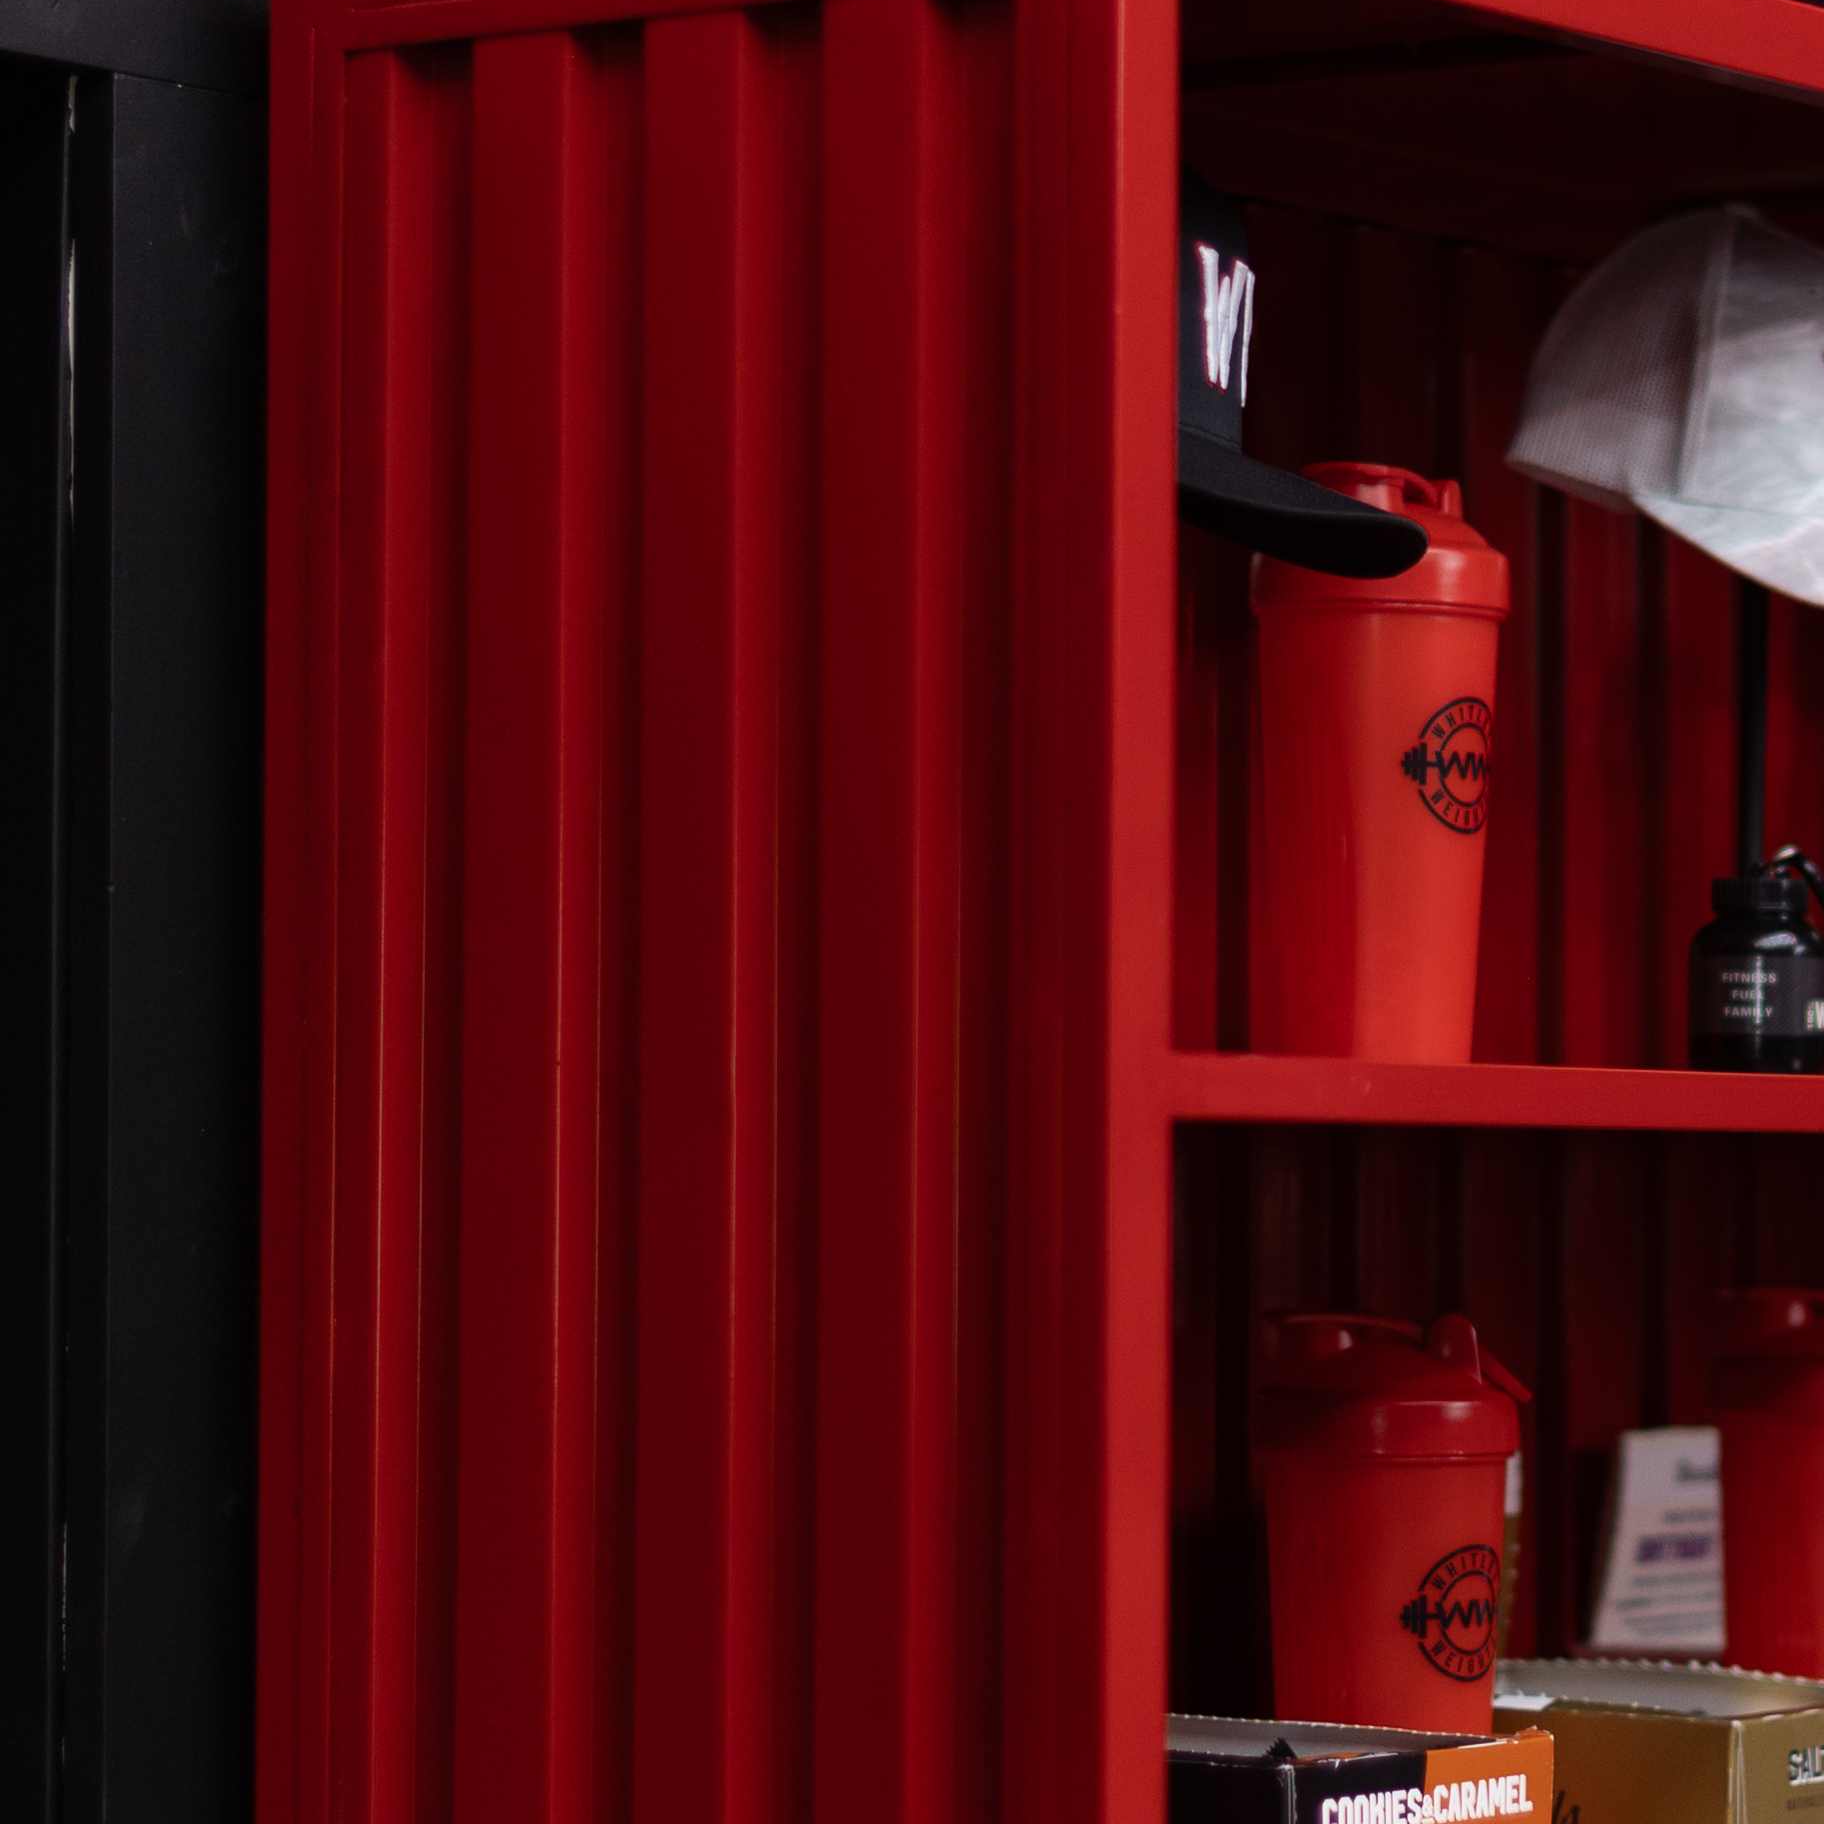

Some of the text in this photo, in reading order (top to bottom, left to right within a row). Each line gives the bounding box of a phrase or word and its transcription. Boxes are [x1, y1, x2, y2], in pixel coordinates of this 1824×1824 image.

[1722, 972, 1776, 984] FITNESS
[1732, 989, 1765, 1000] FUEL
[1724, 1006, 1773, 1018] FAMILY
